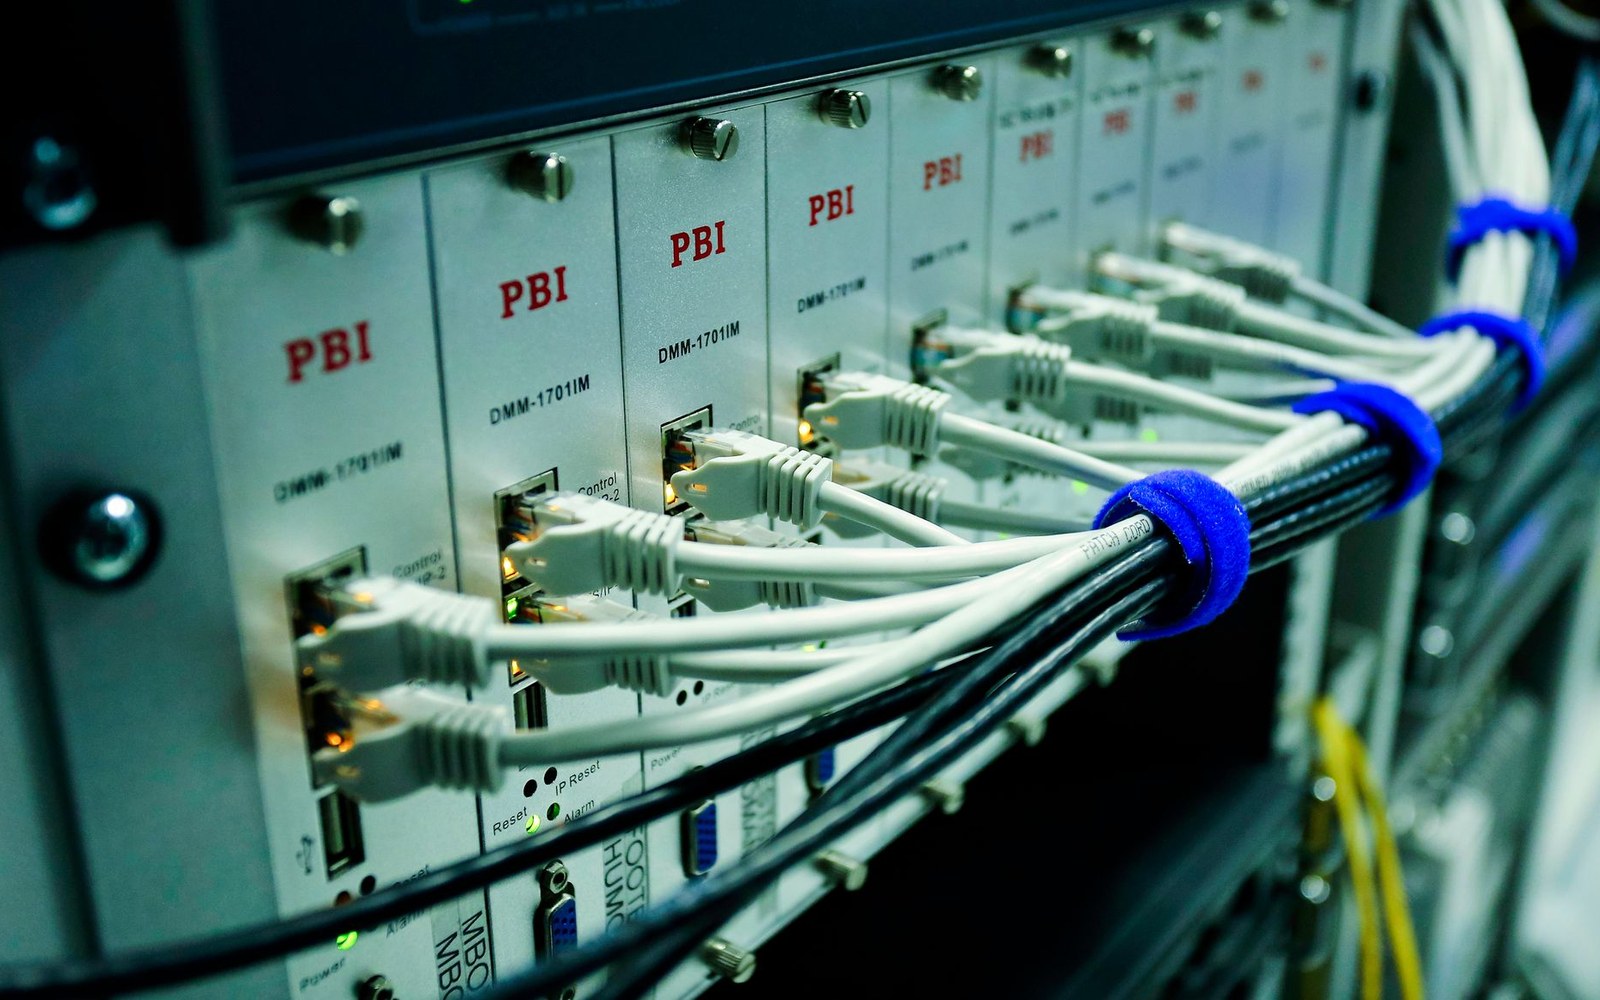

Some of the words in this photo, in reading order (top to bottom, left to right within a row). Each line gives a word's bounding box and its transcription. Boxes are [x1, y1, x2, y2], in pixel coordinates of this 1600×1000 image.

[923, 153, 963, 190] PBI
[808, 185, 855, 226] PBI
[670, 220, 726, 268] PBI
[499, 266, 569, 319] PBI
[798, 277, 866, 313] DMM-1701IM
[285, 321, 373, 383] PBI
[658, 320, 740, 364] DMM-1701IM
[489, 374, 591, 426] DMM-1701IM
[273, 441, 404, 503] DMM-1701IM
[1080, 530, 1121, 560] PATCH
[1123, 518, 1151, 543] CORD
[555, 780, 567, 796] IP
[569, 760, 600, 787] Reset
[493, 806, 527, 836] Reset
[564, 799, 595, 825] Alarm
[462, 910, 489, 991] MBO
[300, 957, 346, 990] Power
